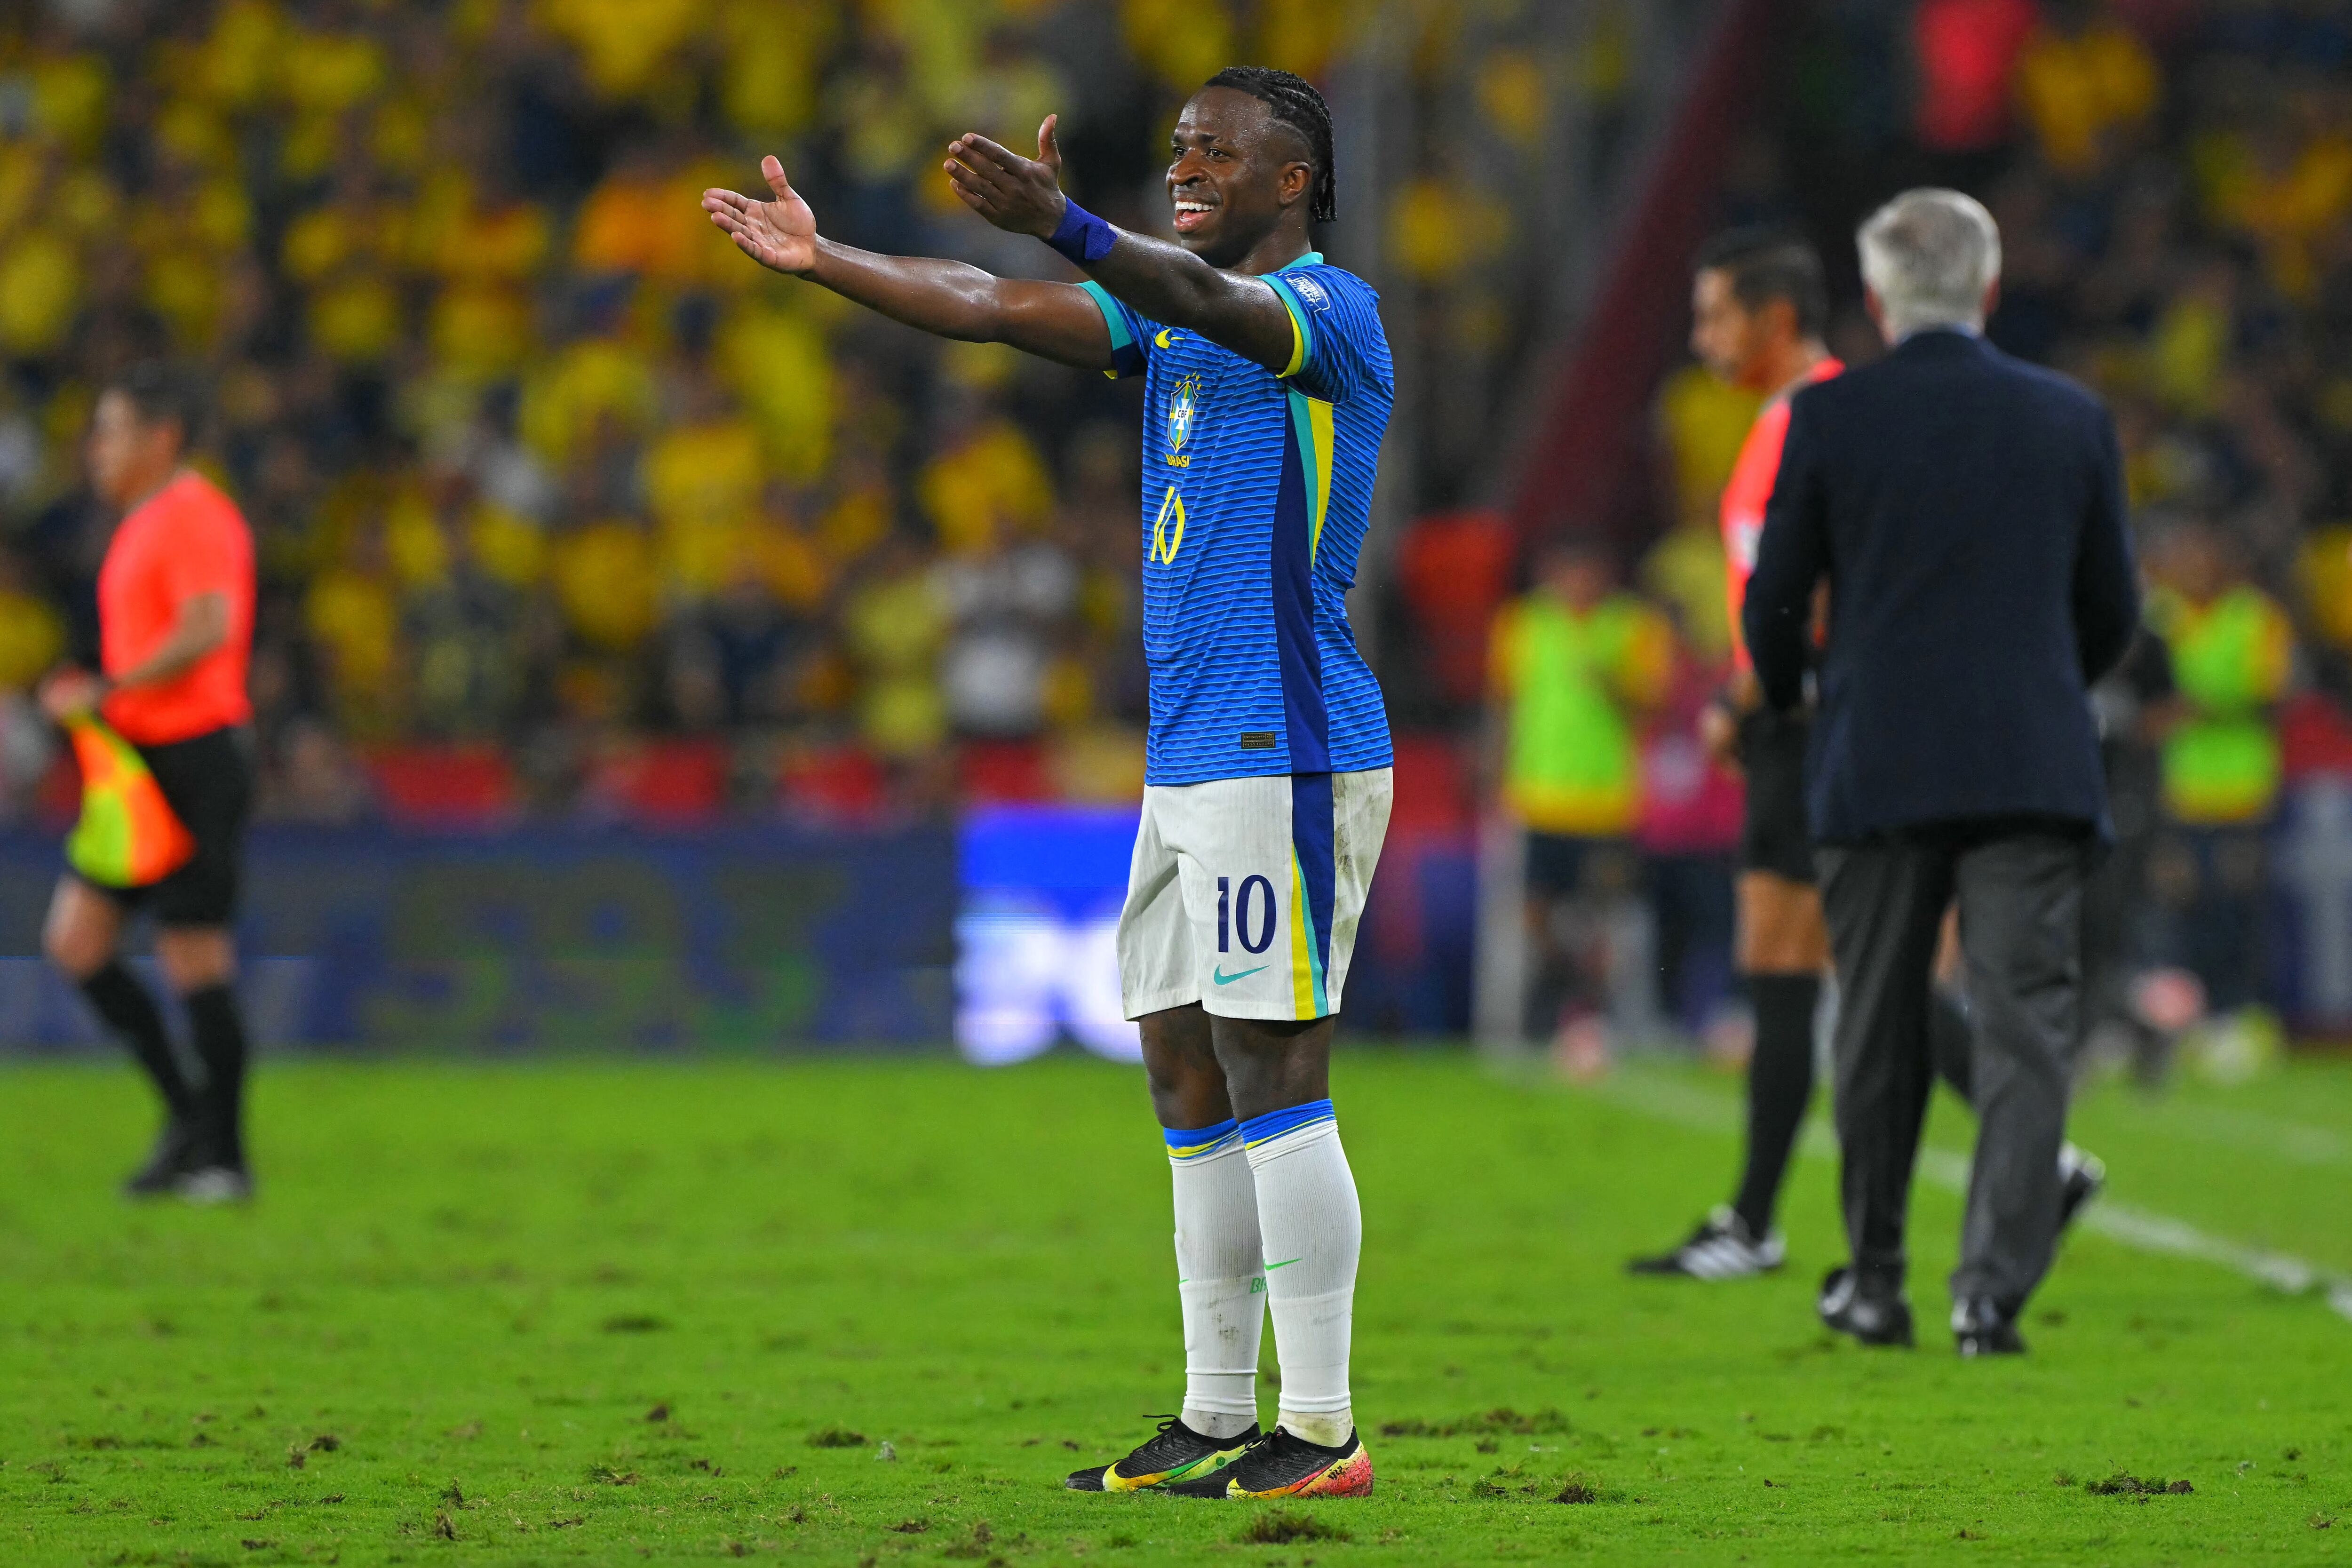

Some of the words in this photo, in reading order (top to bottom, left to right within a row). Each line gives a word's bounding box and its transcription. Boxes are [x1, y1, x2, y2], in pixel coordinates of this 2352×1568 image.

[1298, 276, 1322, 302] FOOTBALL
[1165, 454, 1190, 468] BRASI
[1150, 486, 1185, 565] 10
[1217, 874, 1277, 954] 10
